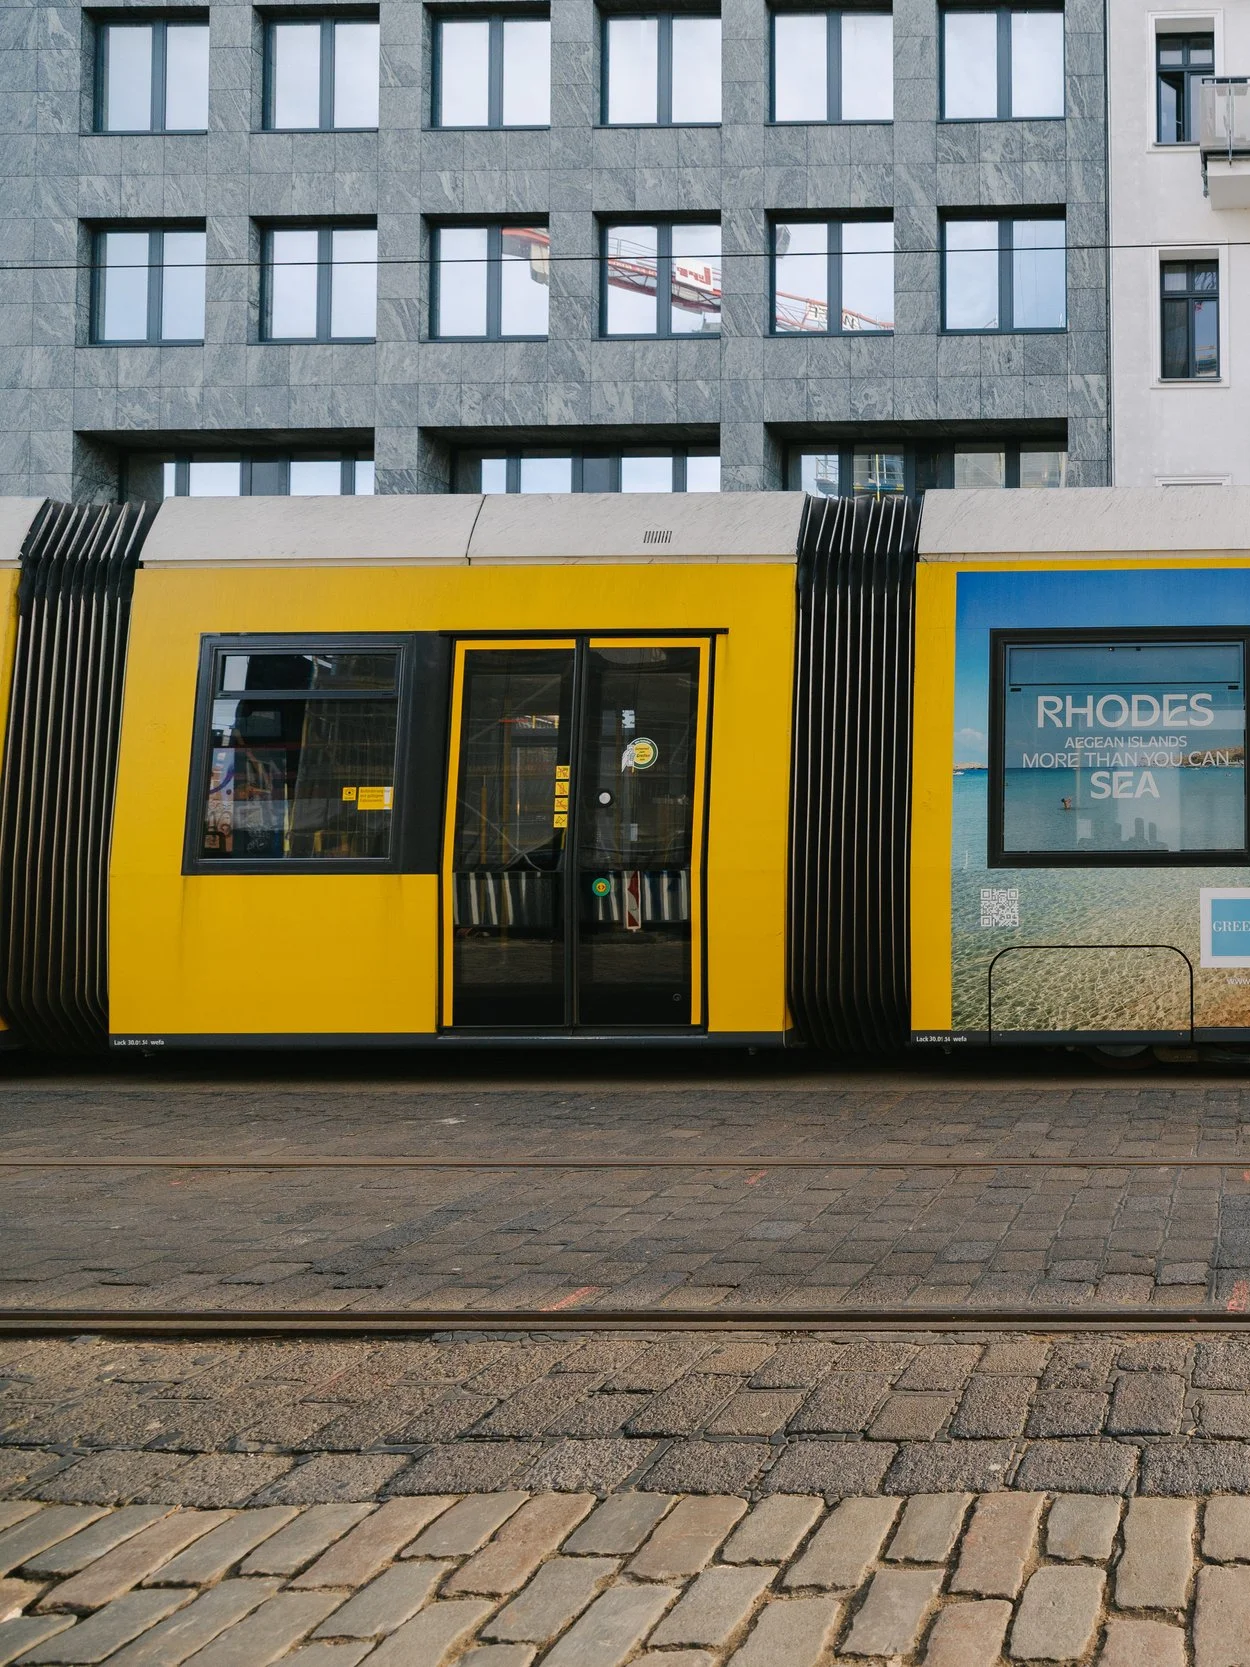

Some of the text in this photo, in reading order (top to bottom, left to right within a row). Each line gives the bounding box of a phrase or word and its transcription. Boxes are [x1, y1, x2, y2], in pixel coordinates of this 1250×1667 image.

[1037, 693, 1215, 728] RHODES
[1064, 735, 1187, 749] AEGEAN ISLANDS
[1022, 750, 1229, 768] MORE THAN YOU CAN
[1090, 770, 1160, 800] SEA
